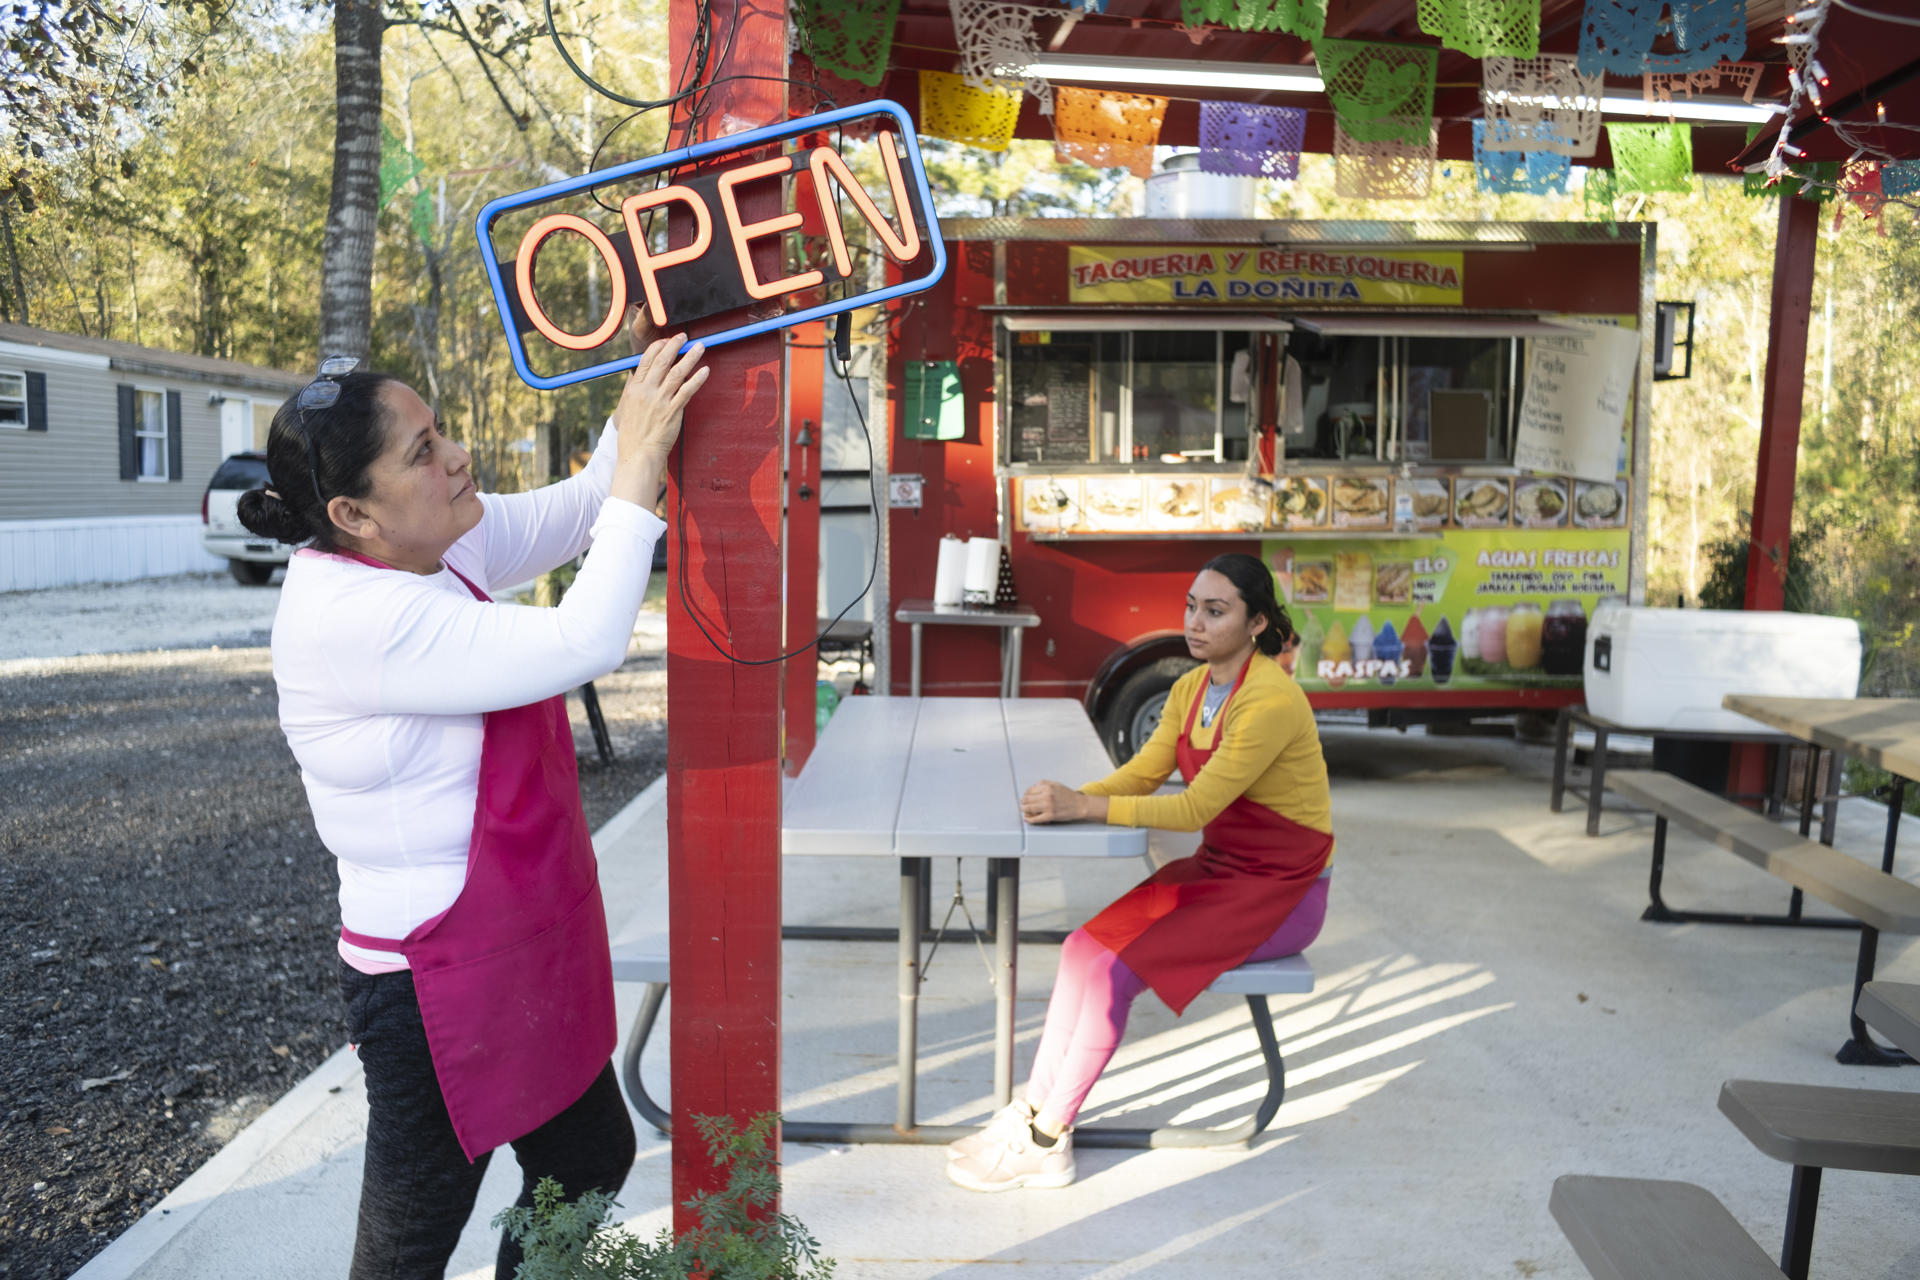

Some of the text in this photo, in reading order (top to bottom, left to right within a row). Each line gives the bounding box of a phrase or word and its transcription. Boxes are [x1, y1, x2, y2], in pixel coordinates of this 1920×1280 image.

[515, 129, 920, 351] OPEN
[1073, 249, 1461, 289] TAQUERIA Y REFRESQUERIA
[1172, 276, 1361, 300] LA DOÑITA
[1476, 550, 1620, 569] AGUAS FRESCAS
[1317, 659, 1412, 679] RASPAS
